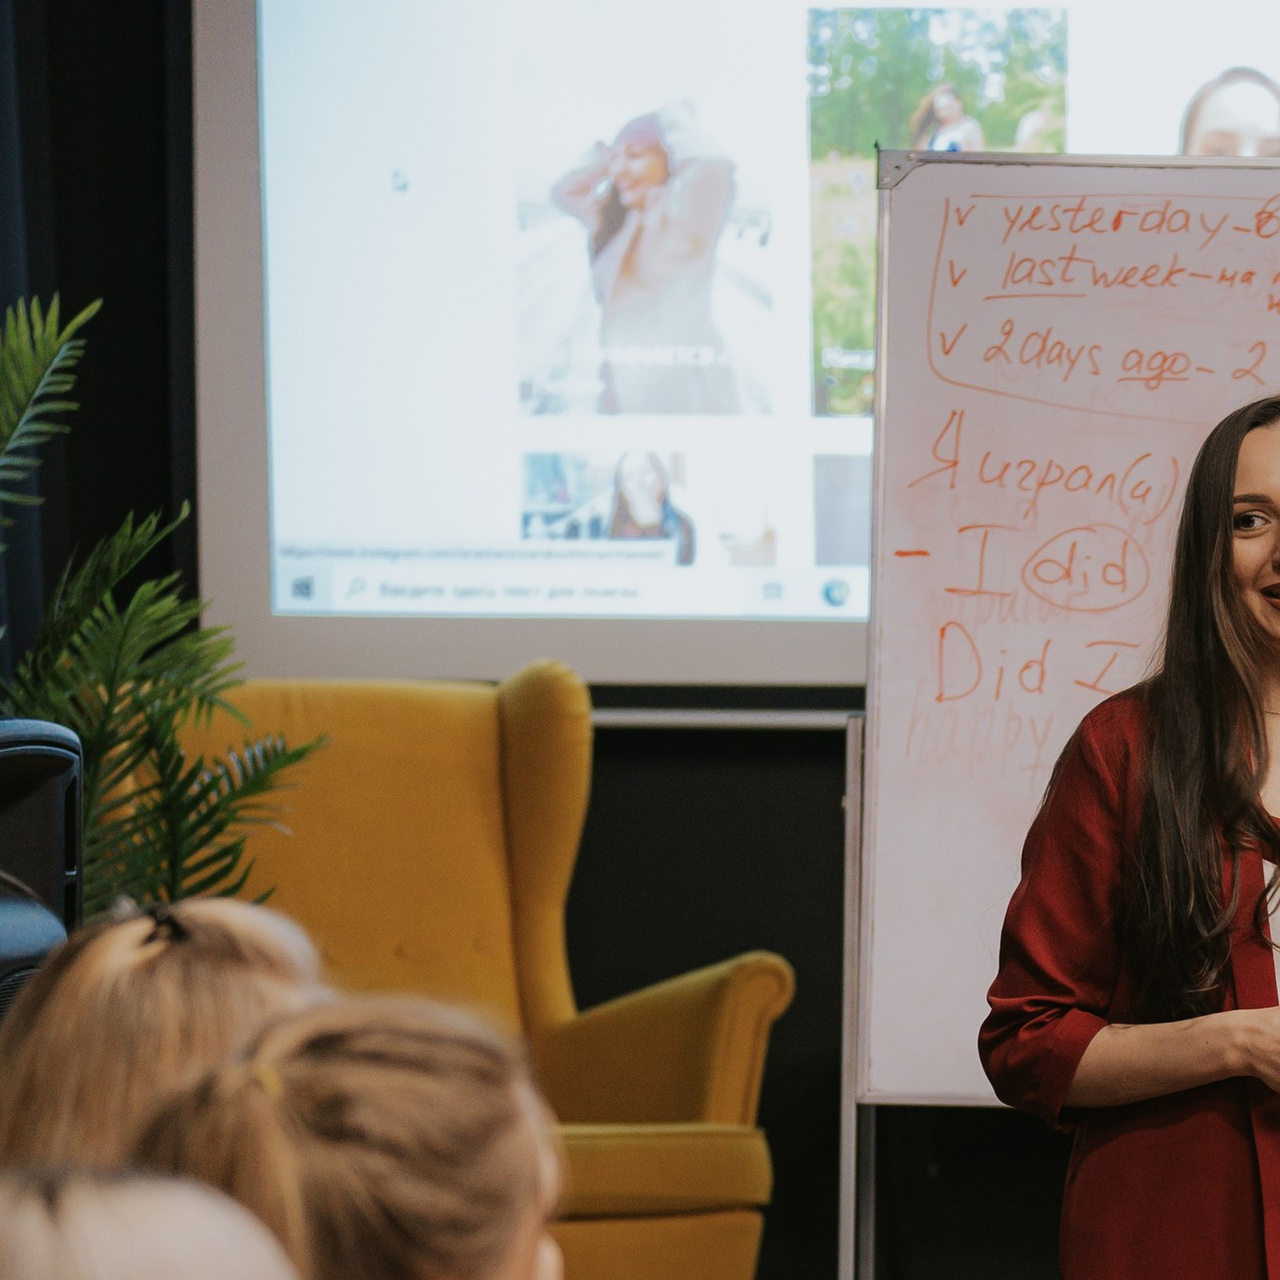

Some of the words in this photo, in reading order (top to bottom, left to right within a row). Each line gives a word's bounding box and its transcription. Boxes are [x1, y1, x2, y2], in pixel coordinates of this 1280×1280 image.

[1001, 196, 1229, 251] yesterday
[1119, 348, 1192, 388] ago
[944, 523, 1022, 597] I
[1032, 538, 1130, 594] did
[934, 619, 1053, 704] Did
